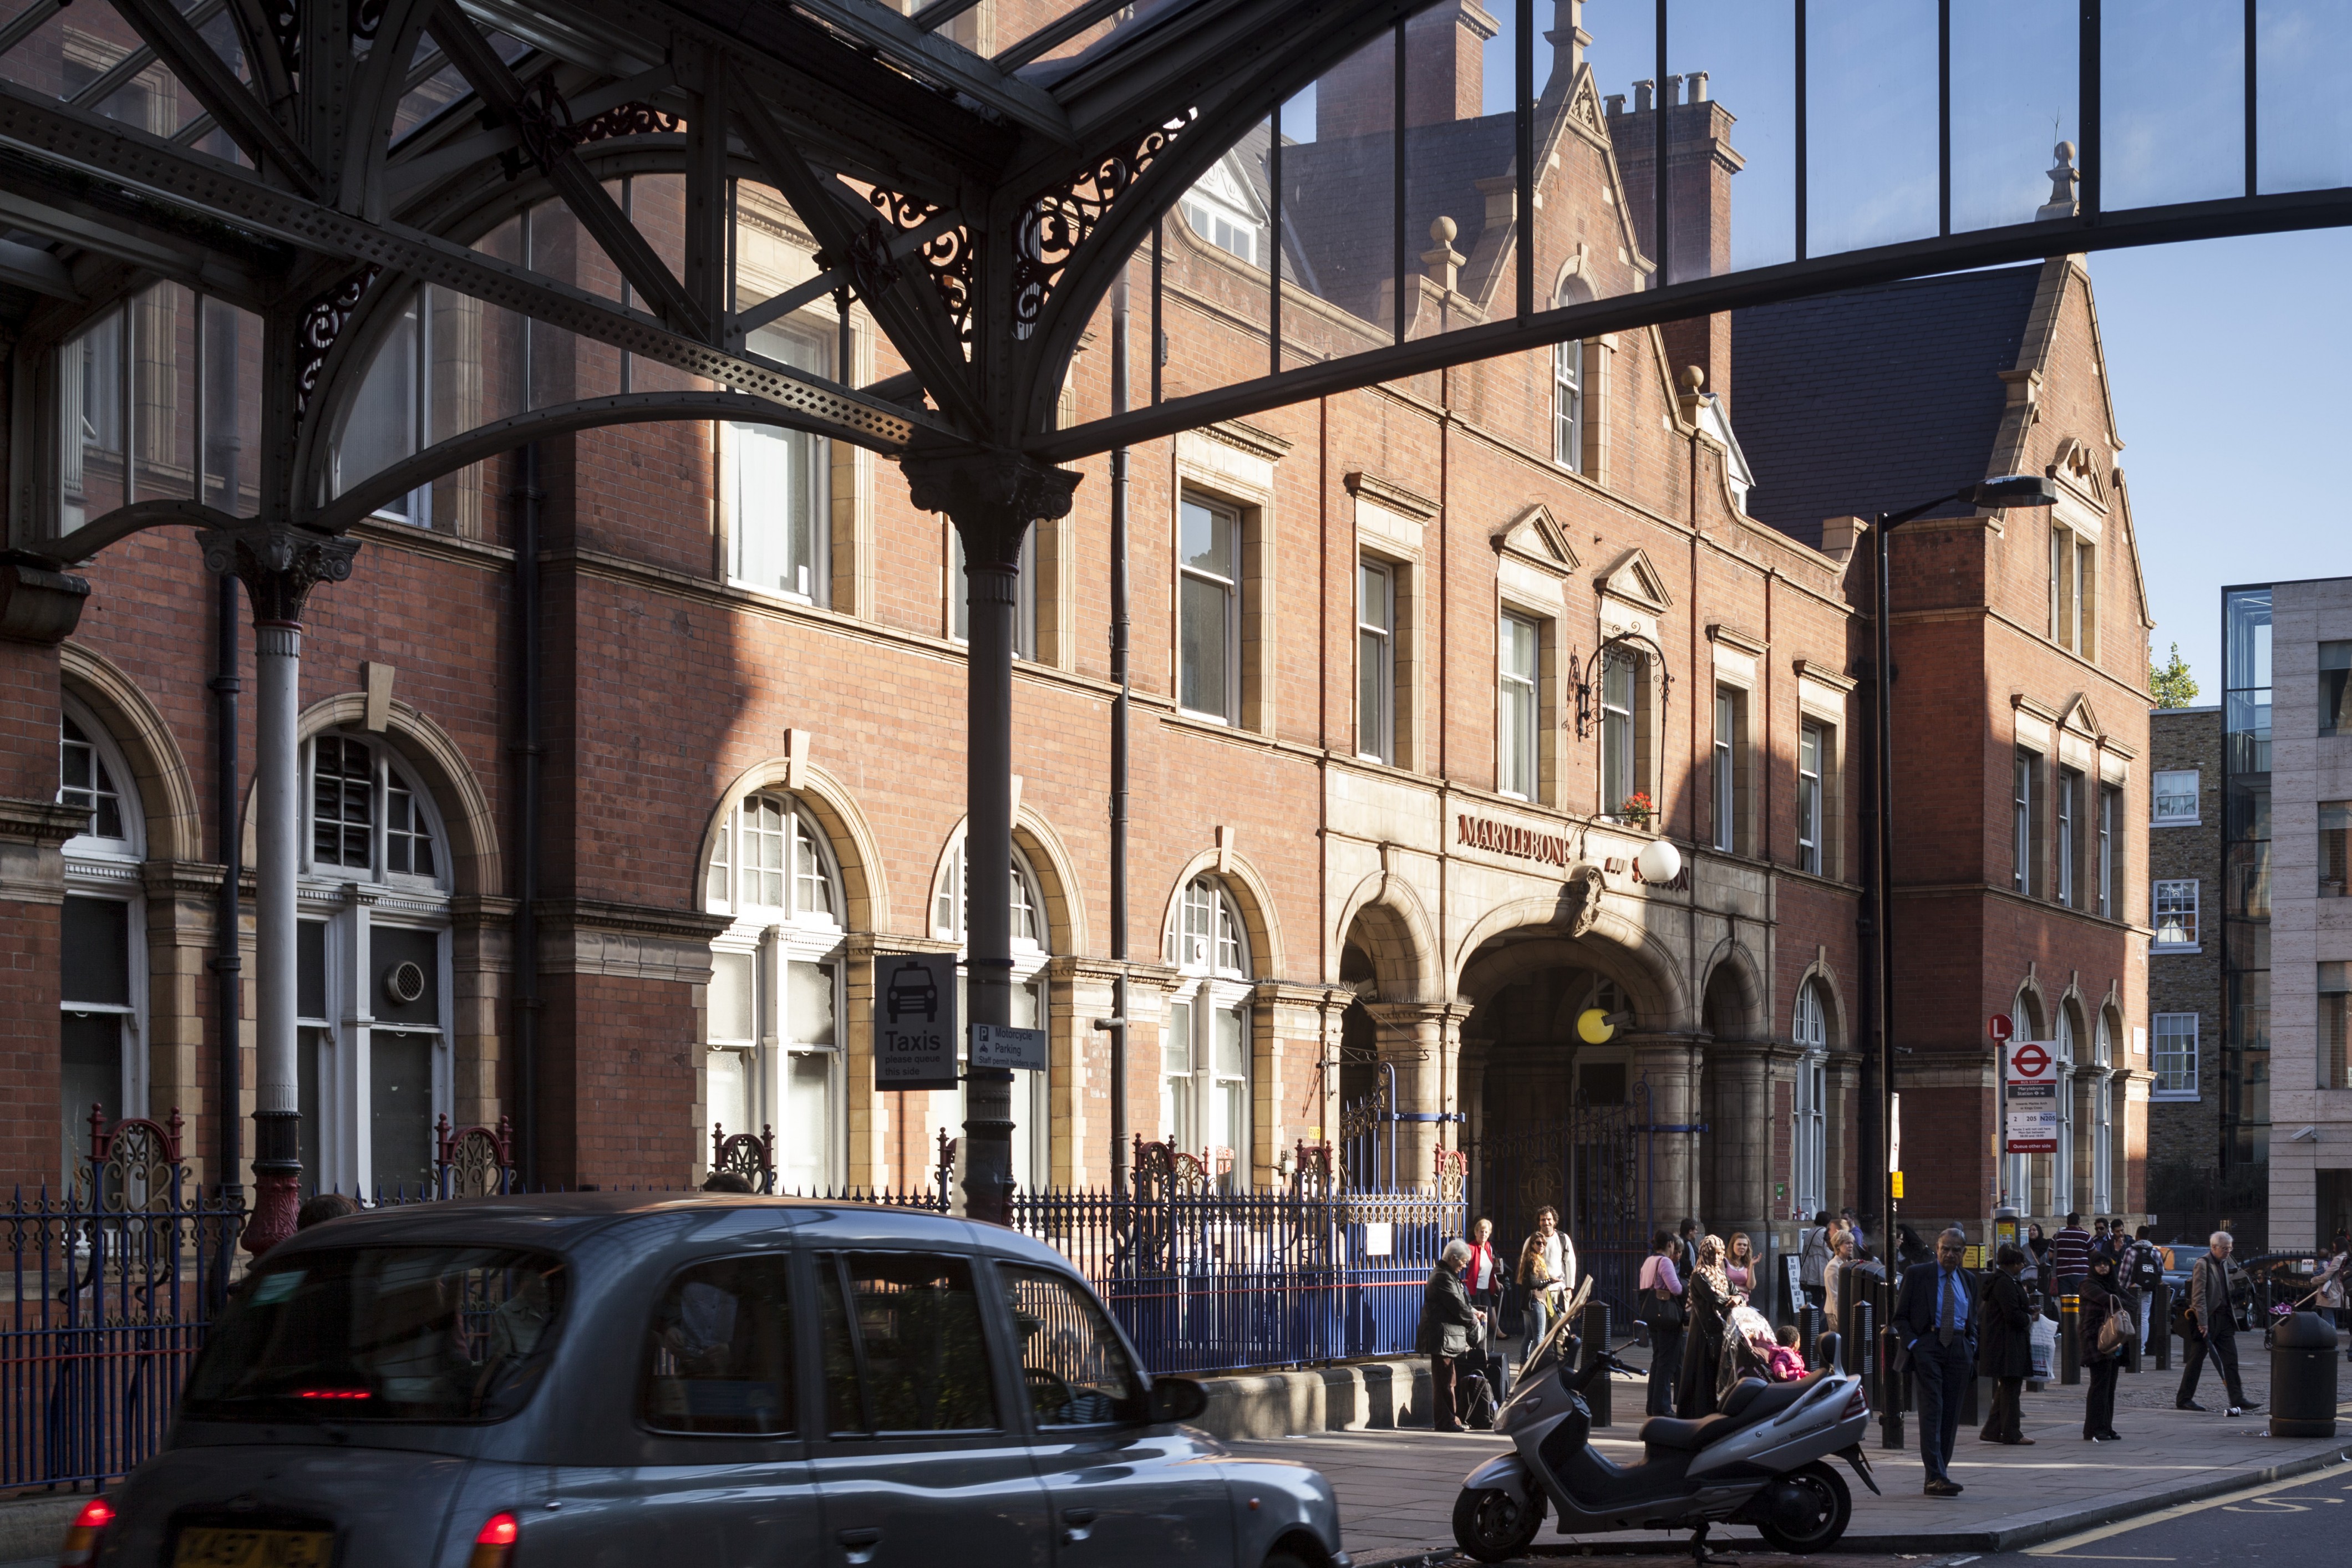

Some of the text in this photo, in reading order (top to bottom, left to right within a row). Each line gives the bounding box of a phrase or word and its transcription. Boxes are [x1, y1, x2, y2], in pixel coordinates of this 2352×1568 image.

[1457, 814, 1571, 868] MARYLEBONE
[995, 1027, 1033, 1041] Motorcycle
[1993, 1019, 2005, 1038] L
[885, 1030, 941, 1052] Taxis
[995, 1043, 1022, 1057] Parking
[885, 1055, 941, 1065] please queue
[979, 1056, 992, 1064] Staff
[993, 1057, 1009, 1066] permit
[1010, 1058, 1029, 1067] holders
[885, 1067, 920, 1076] this side
[1310, 1128, 1320, 1137] RVP
